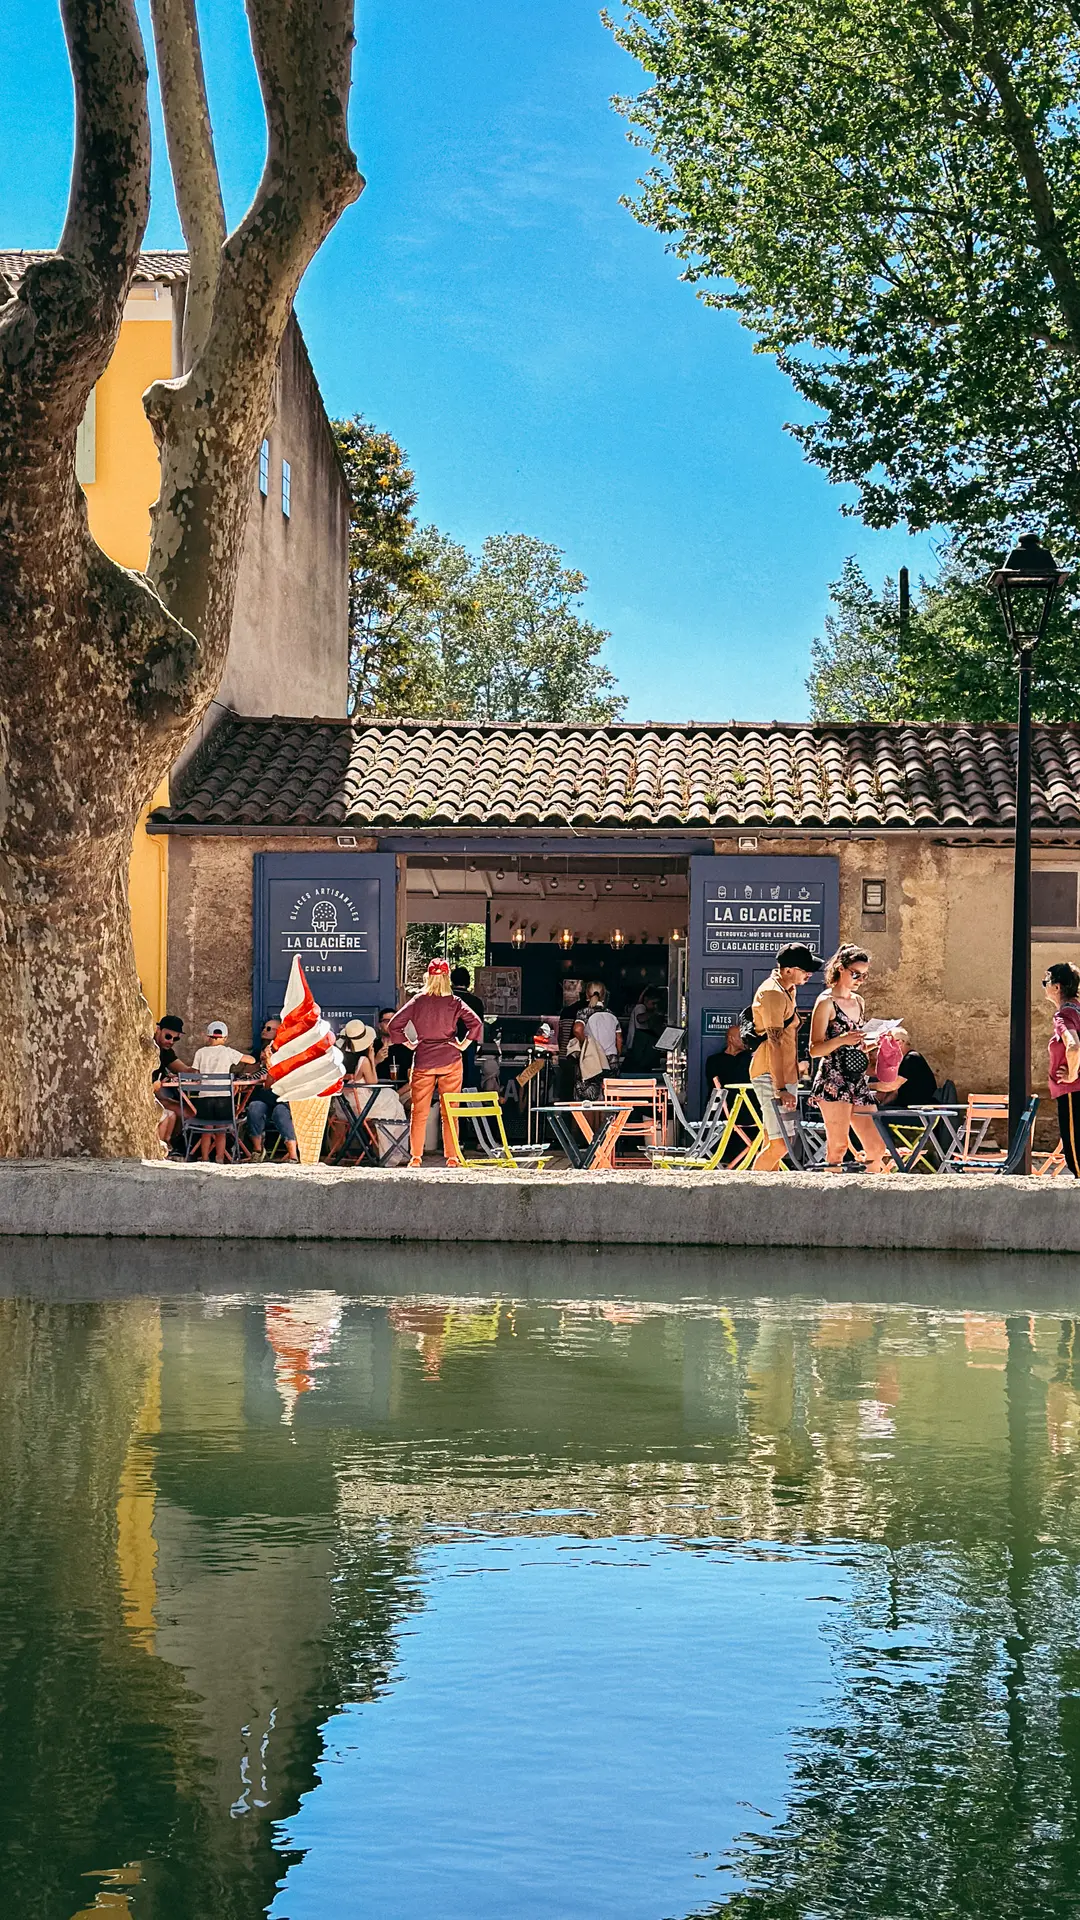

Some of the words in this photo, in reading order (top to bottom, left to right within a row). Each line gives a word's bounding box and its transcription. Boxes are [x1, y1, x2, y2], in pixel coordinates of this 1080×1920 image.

[290, 892, 311, 920] GLACES
[315, 887, 359, 921] ARTISANALES
[714, 907, 733, 921] LA
[287, 937, 301, 948] LA
[710, 975, 735, 984] CRÊPES
[711, 1014, 732, 1024] PÂTES
